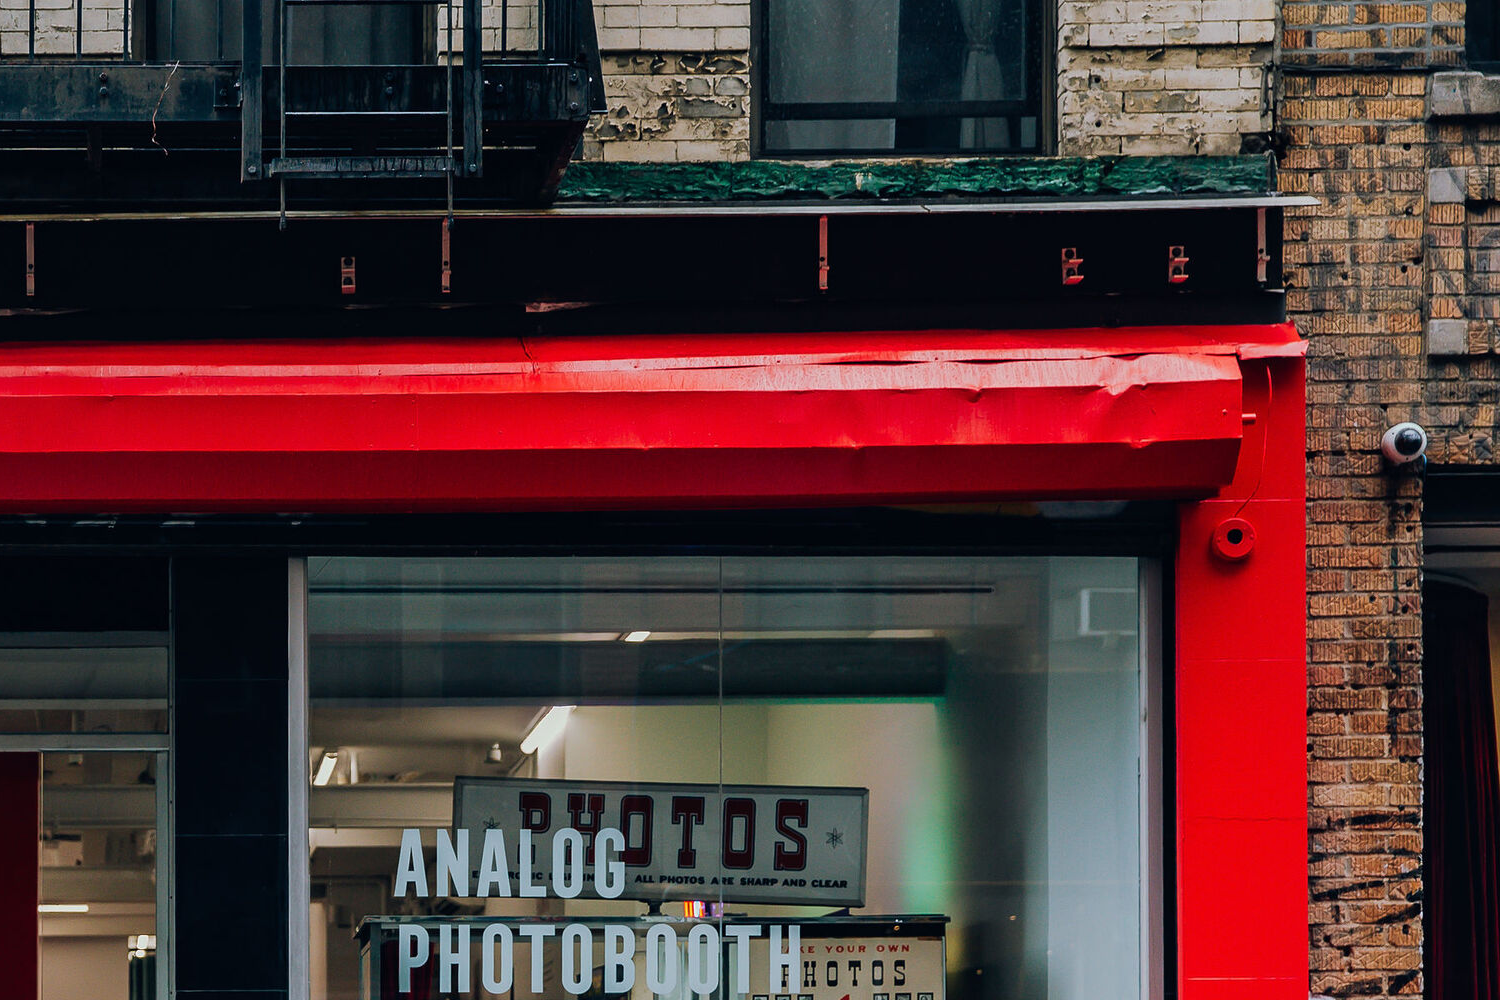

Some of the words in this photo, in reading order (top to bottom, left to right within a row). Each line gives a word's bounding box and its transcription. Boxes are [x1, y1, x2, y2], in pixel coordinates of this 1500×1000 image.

[393, 827, 626, 898] ANALOG
[634, 874, 655, 883] ALL
[659, 875, 705, 884] PHOTOS
[711, 876, 735, 885] ARE
[740, 877, 778, 886] SHARP
[782, 878, 807, 887] AND
[811, 879, 847, 888] CLEAR
[398, 923, 800, 995] PHOTOBOOTH
[825, 945, 867, 954] YOUR
[876, 944, 911, 953] OWN
